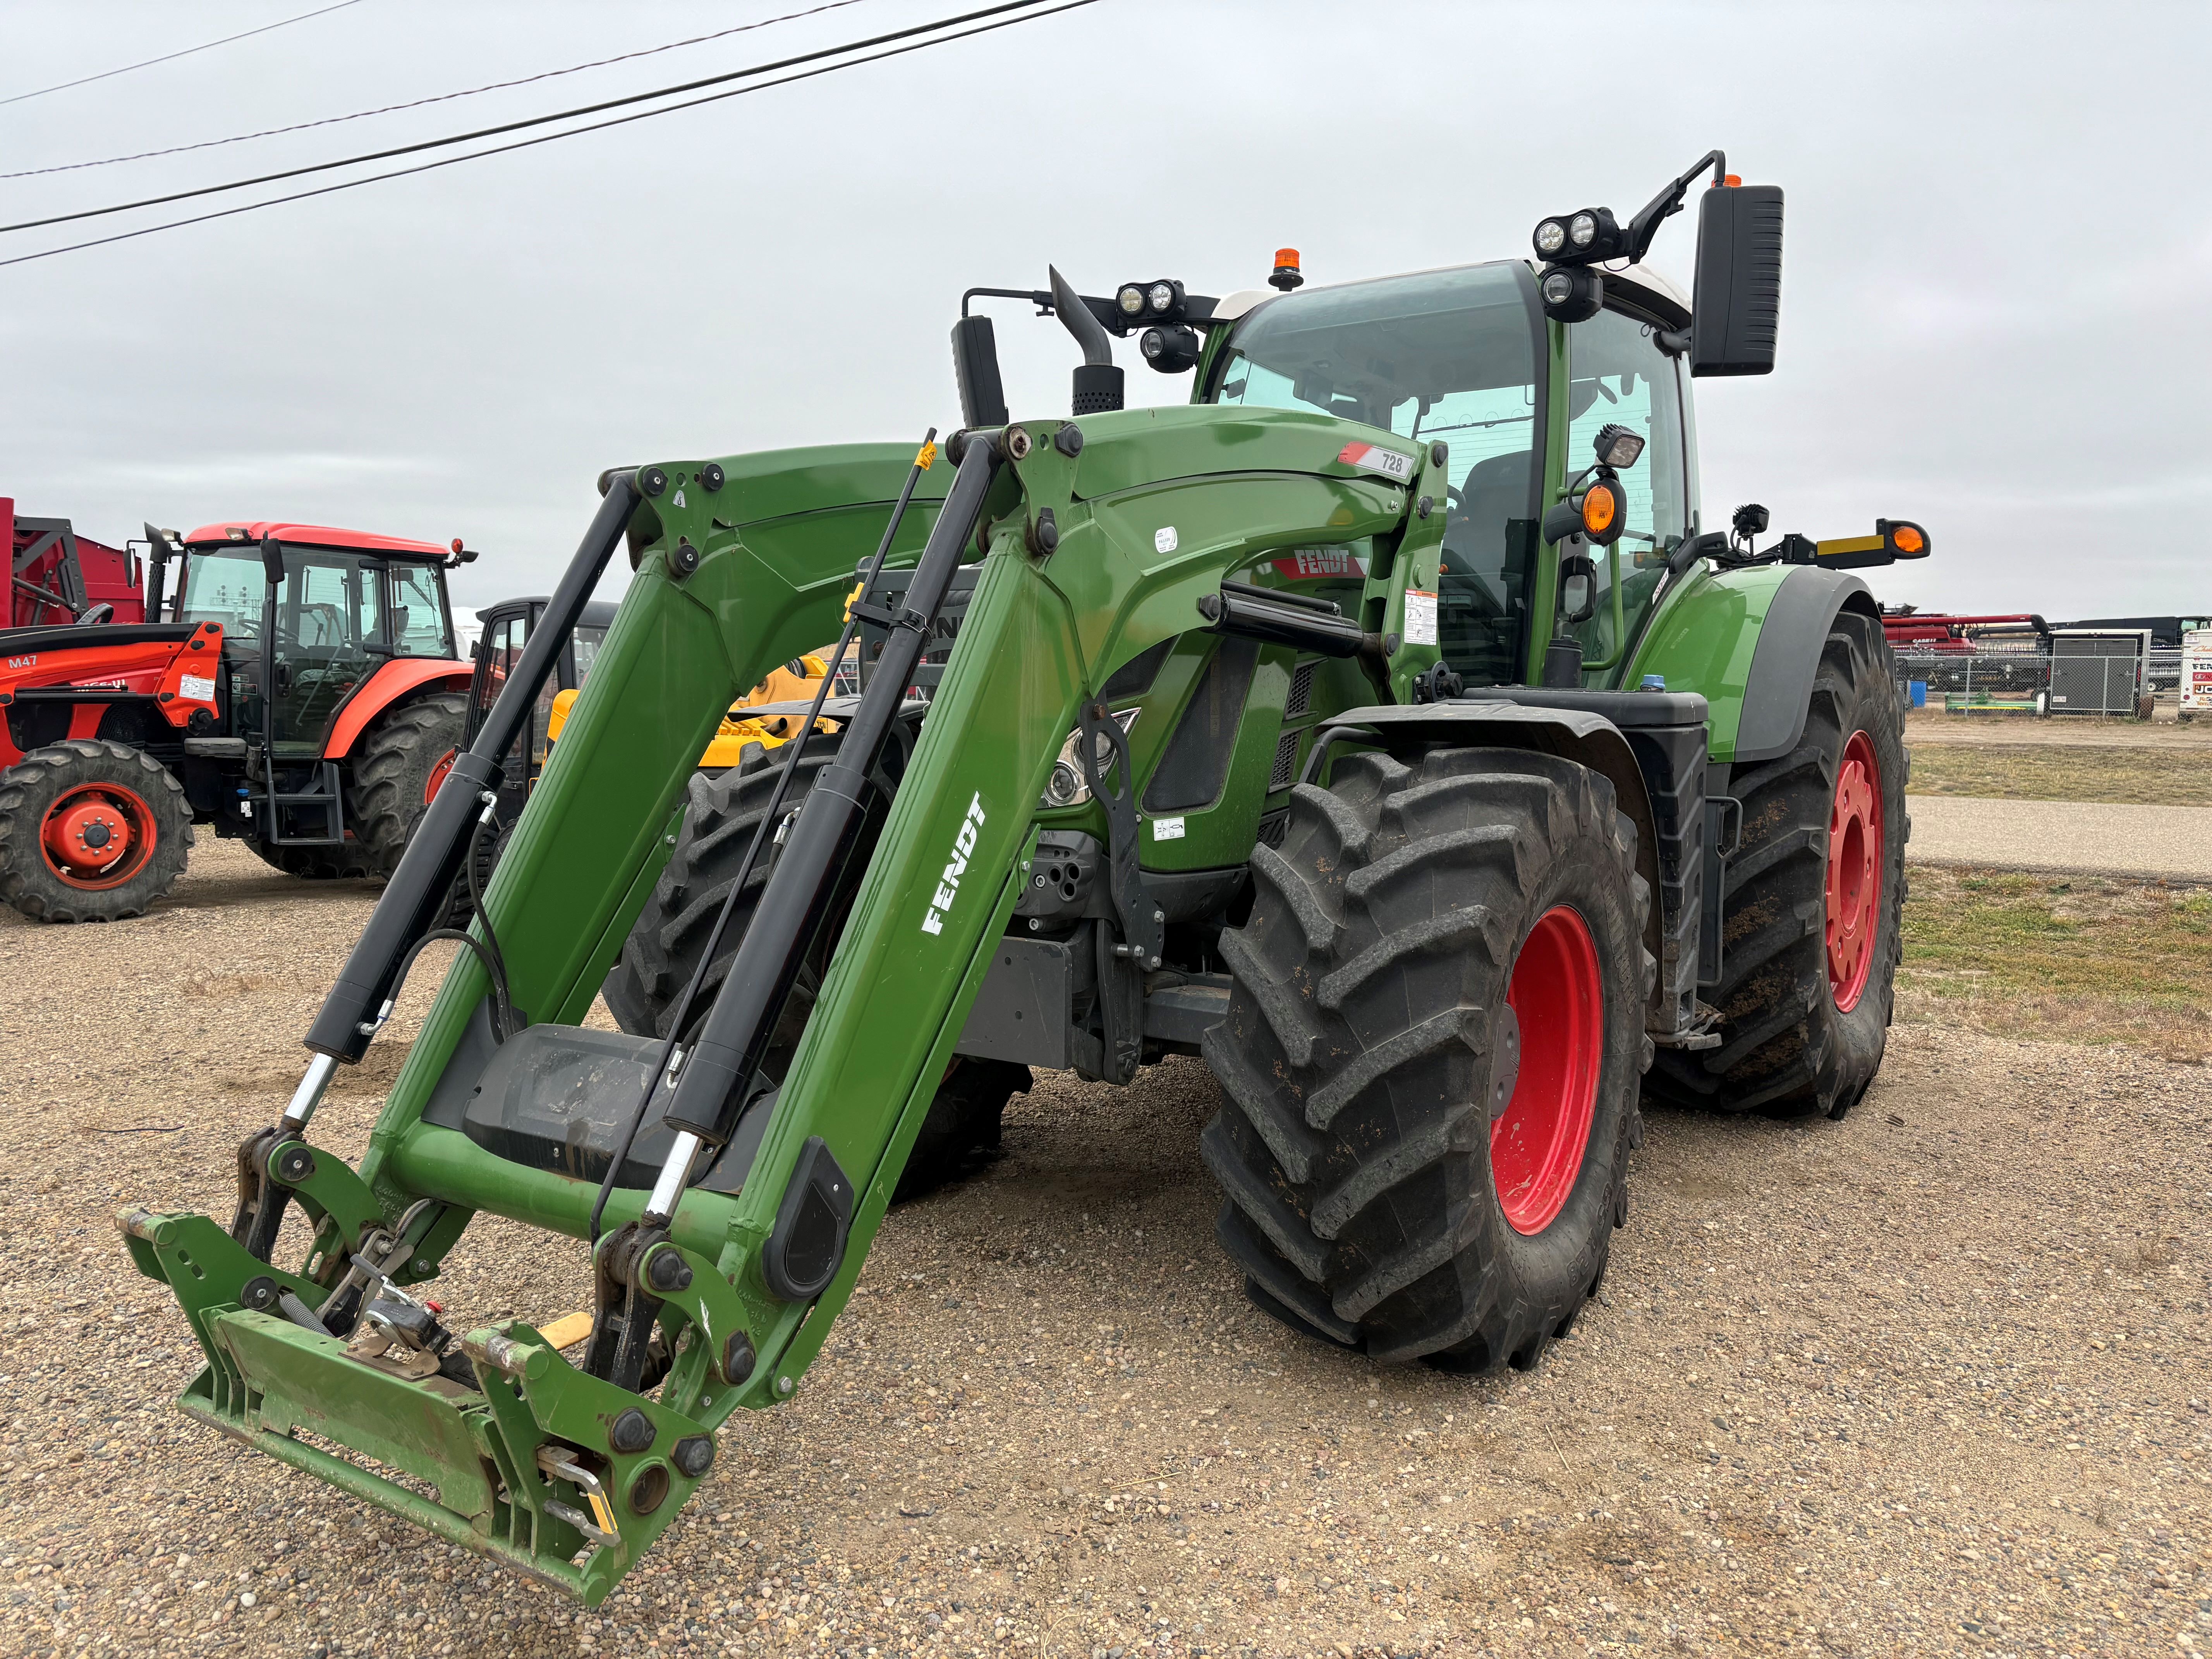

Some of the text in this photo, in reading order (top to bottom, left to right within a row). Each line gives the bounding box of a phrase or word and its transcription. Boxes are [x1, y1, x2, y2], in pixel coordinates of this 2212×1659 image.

[1383, 453, 1403, 473] 728
[1294, 550, 1349, 574] FENDT
[8, 655, 37, 669] M47
[921, 790, 986, 935] FENDT
